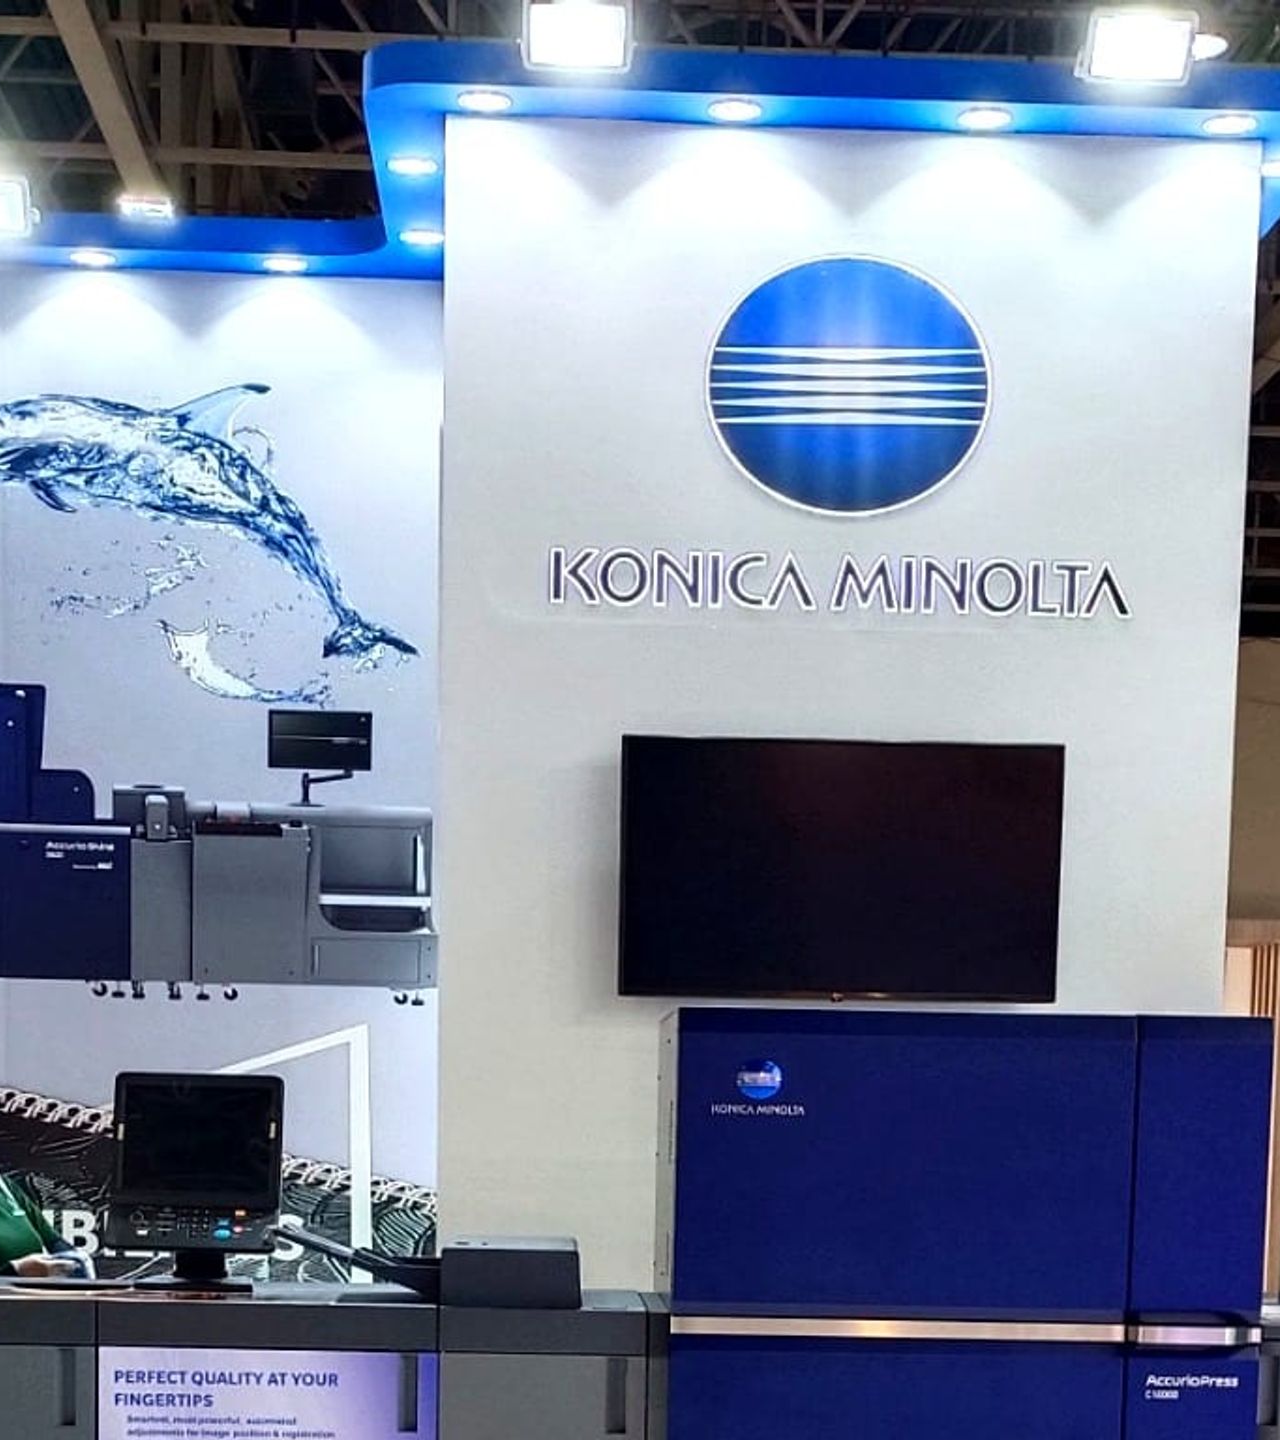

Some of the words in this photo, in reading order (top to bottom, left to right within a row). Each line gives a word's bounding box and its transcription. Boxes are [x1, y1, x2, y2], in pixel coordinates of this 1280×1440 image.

[549, 546, 816, 614] KONICA
[830, 554, 1133, 620] MINOLTA
[711, 1104, 755, 1116] KONICA
[756, 1104, 805, 1116] MINOLTA
[114, 1370, 187, 1386] PERFECT
[191, 1371, 263, 1387] QUALITY
[267, 1373, 289, 1386] AT
[291, 1373, 339, 1387] YOUR
[1145, 1374, 1239, 1387] AccurioPress
[114, 1393, 214, 1408] FINGERTIPS
